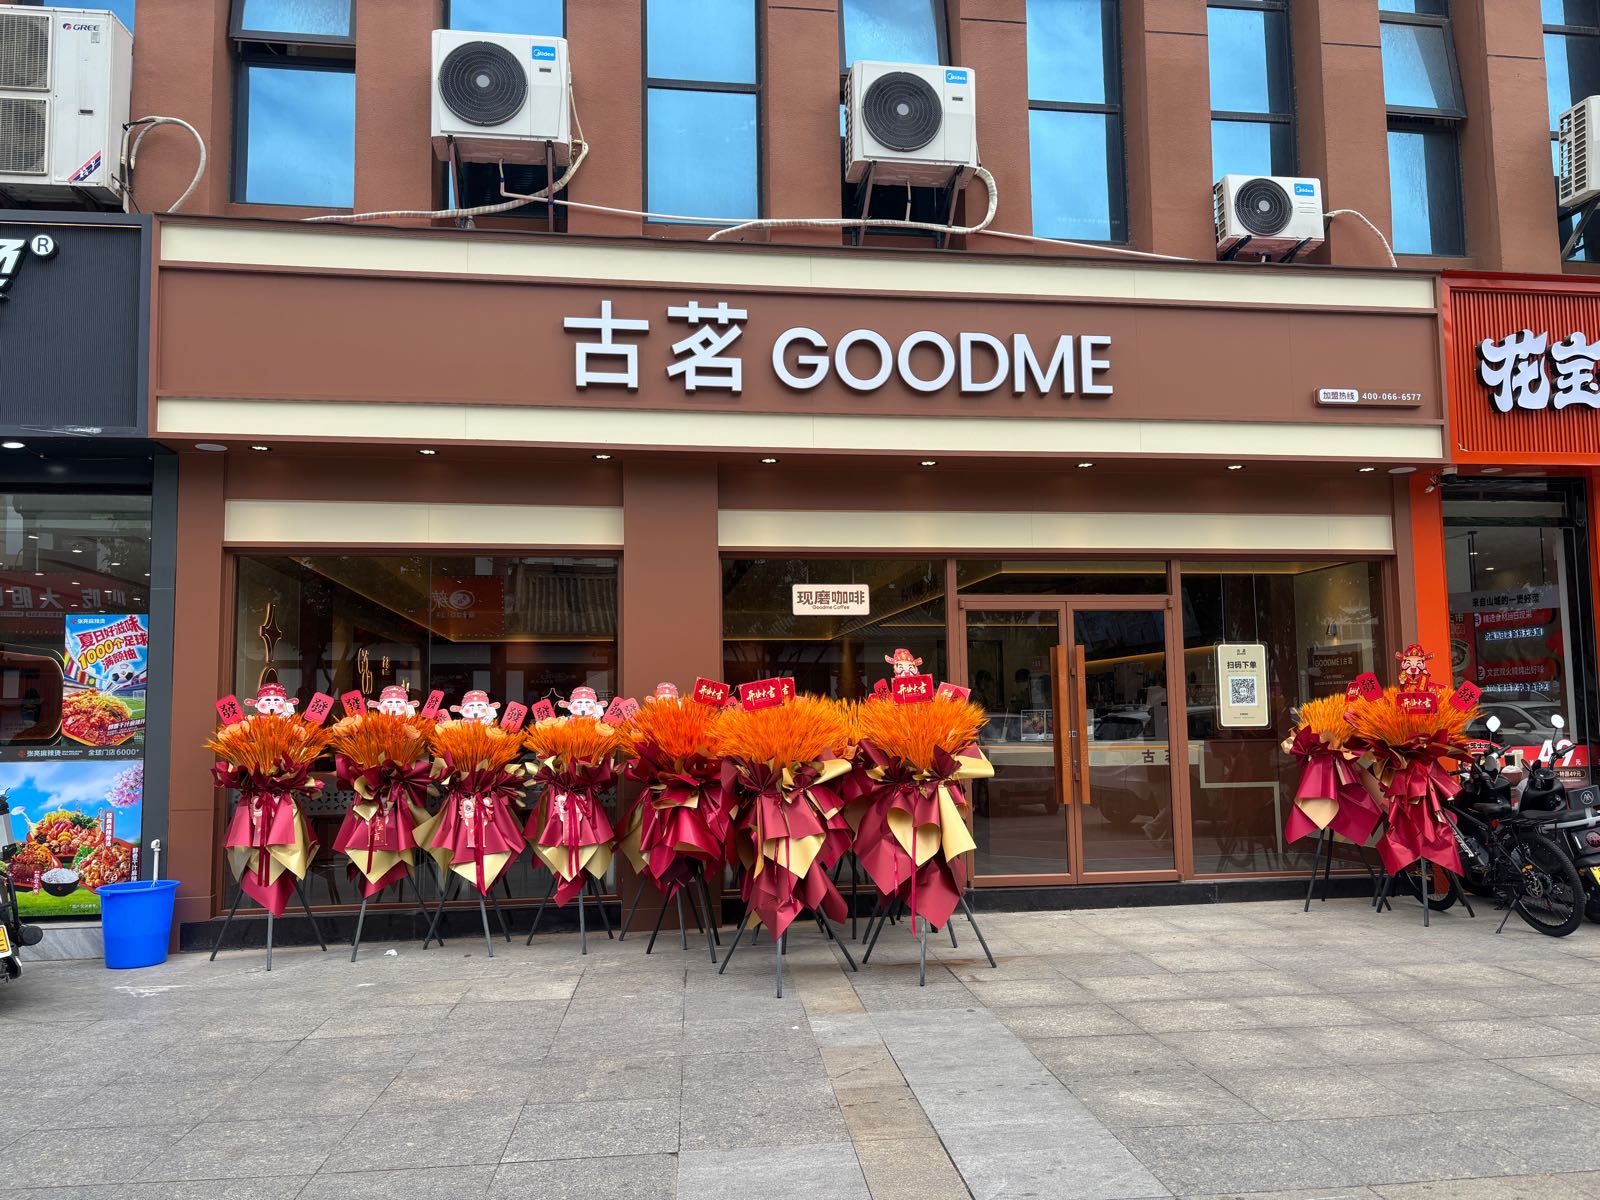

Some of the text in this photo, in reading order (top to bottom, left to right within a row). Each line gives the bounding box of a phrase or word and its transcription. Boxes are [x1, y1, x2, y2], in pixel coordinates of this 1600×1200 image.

[563, 299, 1114, 397] 古茗 GOODME
[1323, 391, 1421, 401] 加盟热线 400-066-6577
[797, 590, 865, 605] 现磨咖啡
[75, 615, 147, 653] 夏日好滋味
[1227, 661, 1257, 669] 扫码下单
[698, 685, 724, 700] 开业大吉
[746, 686, 776, 706] 开业大吉
[897, 682, 927, 700] 开业大吉
[221, 701, 238, 718] 發
[311, 699, 328, 716] 發
